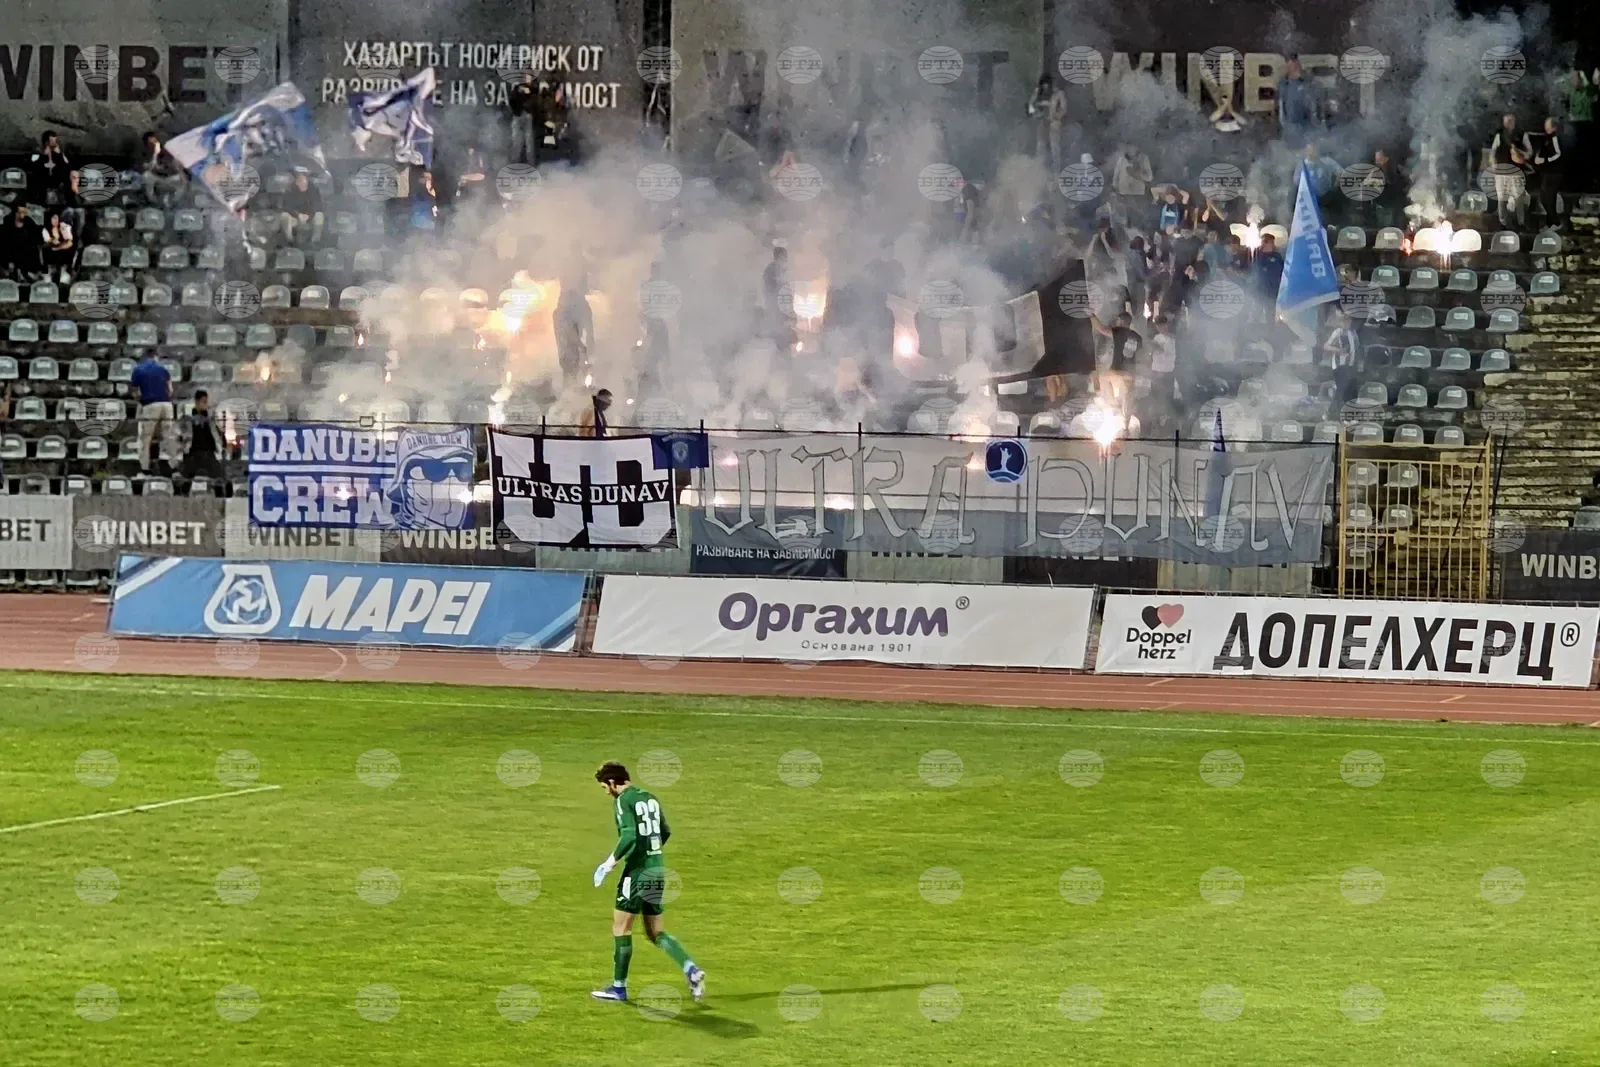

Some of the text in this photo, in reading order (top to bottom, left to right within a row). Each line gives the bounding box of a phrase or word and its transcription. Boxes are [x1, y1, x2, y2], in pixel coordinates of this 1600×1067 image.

[343, 40, 451, 67] ХАЗАРТЪТ
[459, 43, 513, 69] НОСИ
[518, 45, 571, 72] РИСК
[577, 46, 603, 72] ОТ
[450, 81, 478, 105] НА
[253, 427, 397, 464] DANUBE
[252, 474, 396, 526] CREW
[497, 476, 669, 504] ULTRAS DUNAV
[91, 519, 206, 545] WINBET
[401, 526, 510, 551] WINBE
[288, 573, 491, 636] MAPEI
[718, 592, 949, 641] Оргахим
[801, 639, 912, 653] Основана 1901
[1126, 627, 1192, 647] Doppel
[1138, 644, 1177, 660] herz
[635, 798, 661, 836] 33
